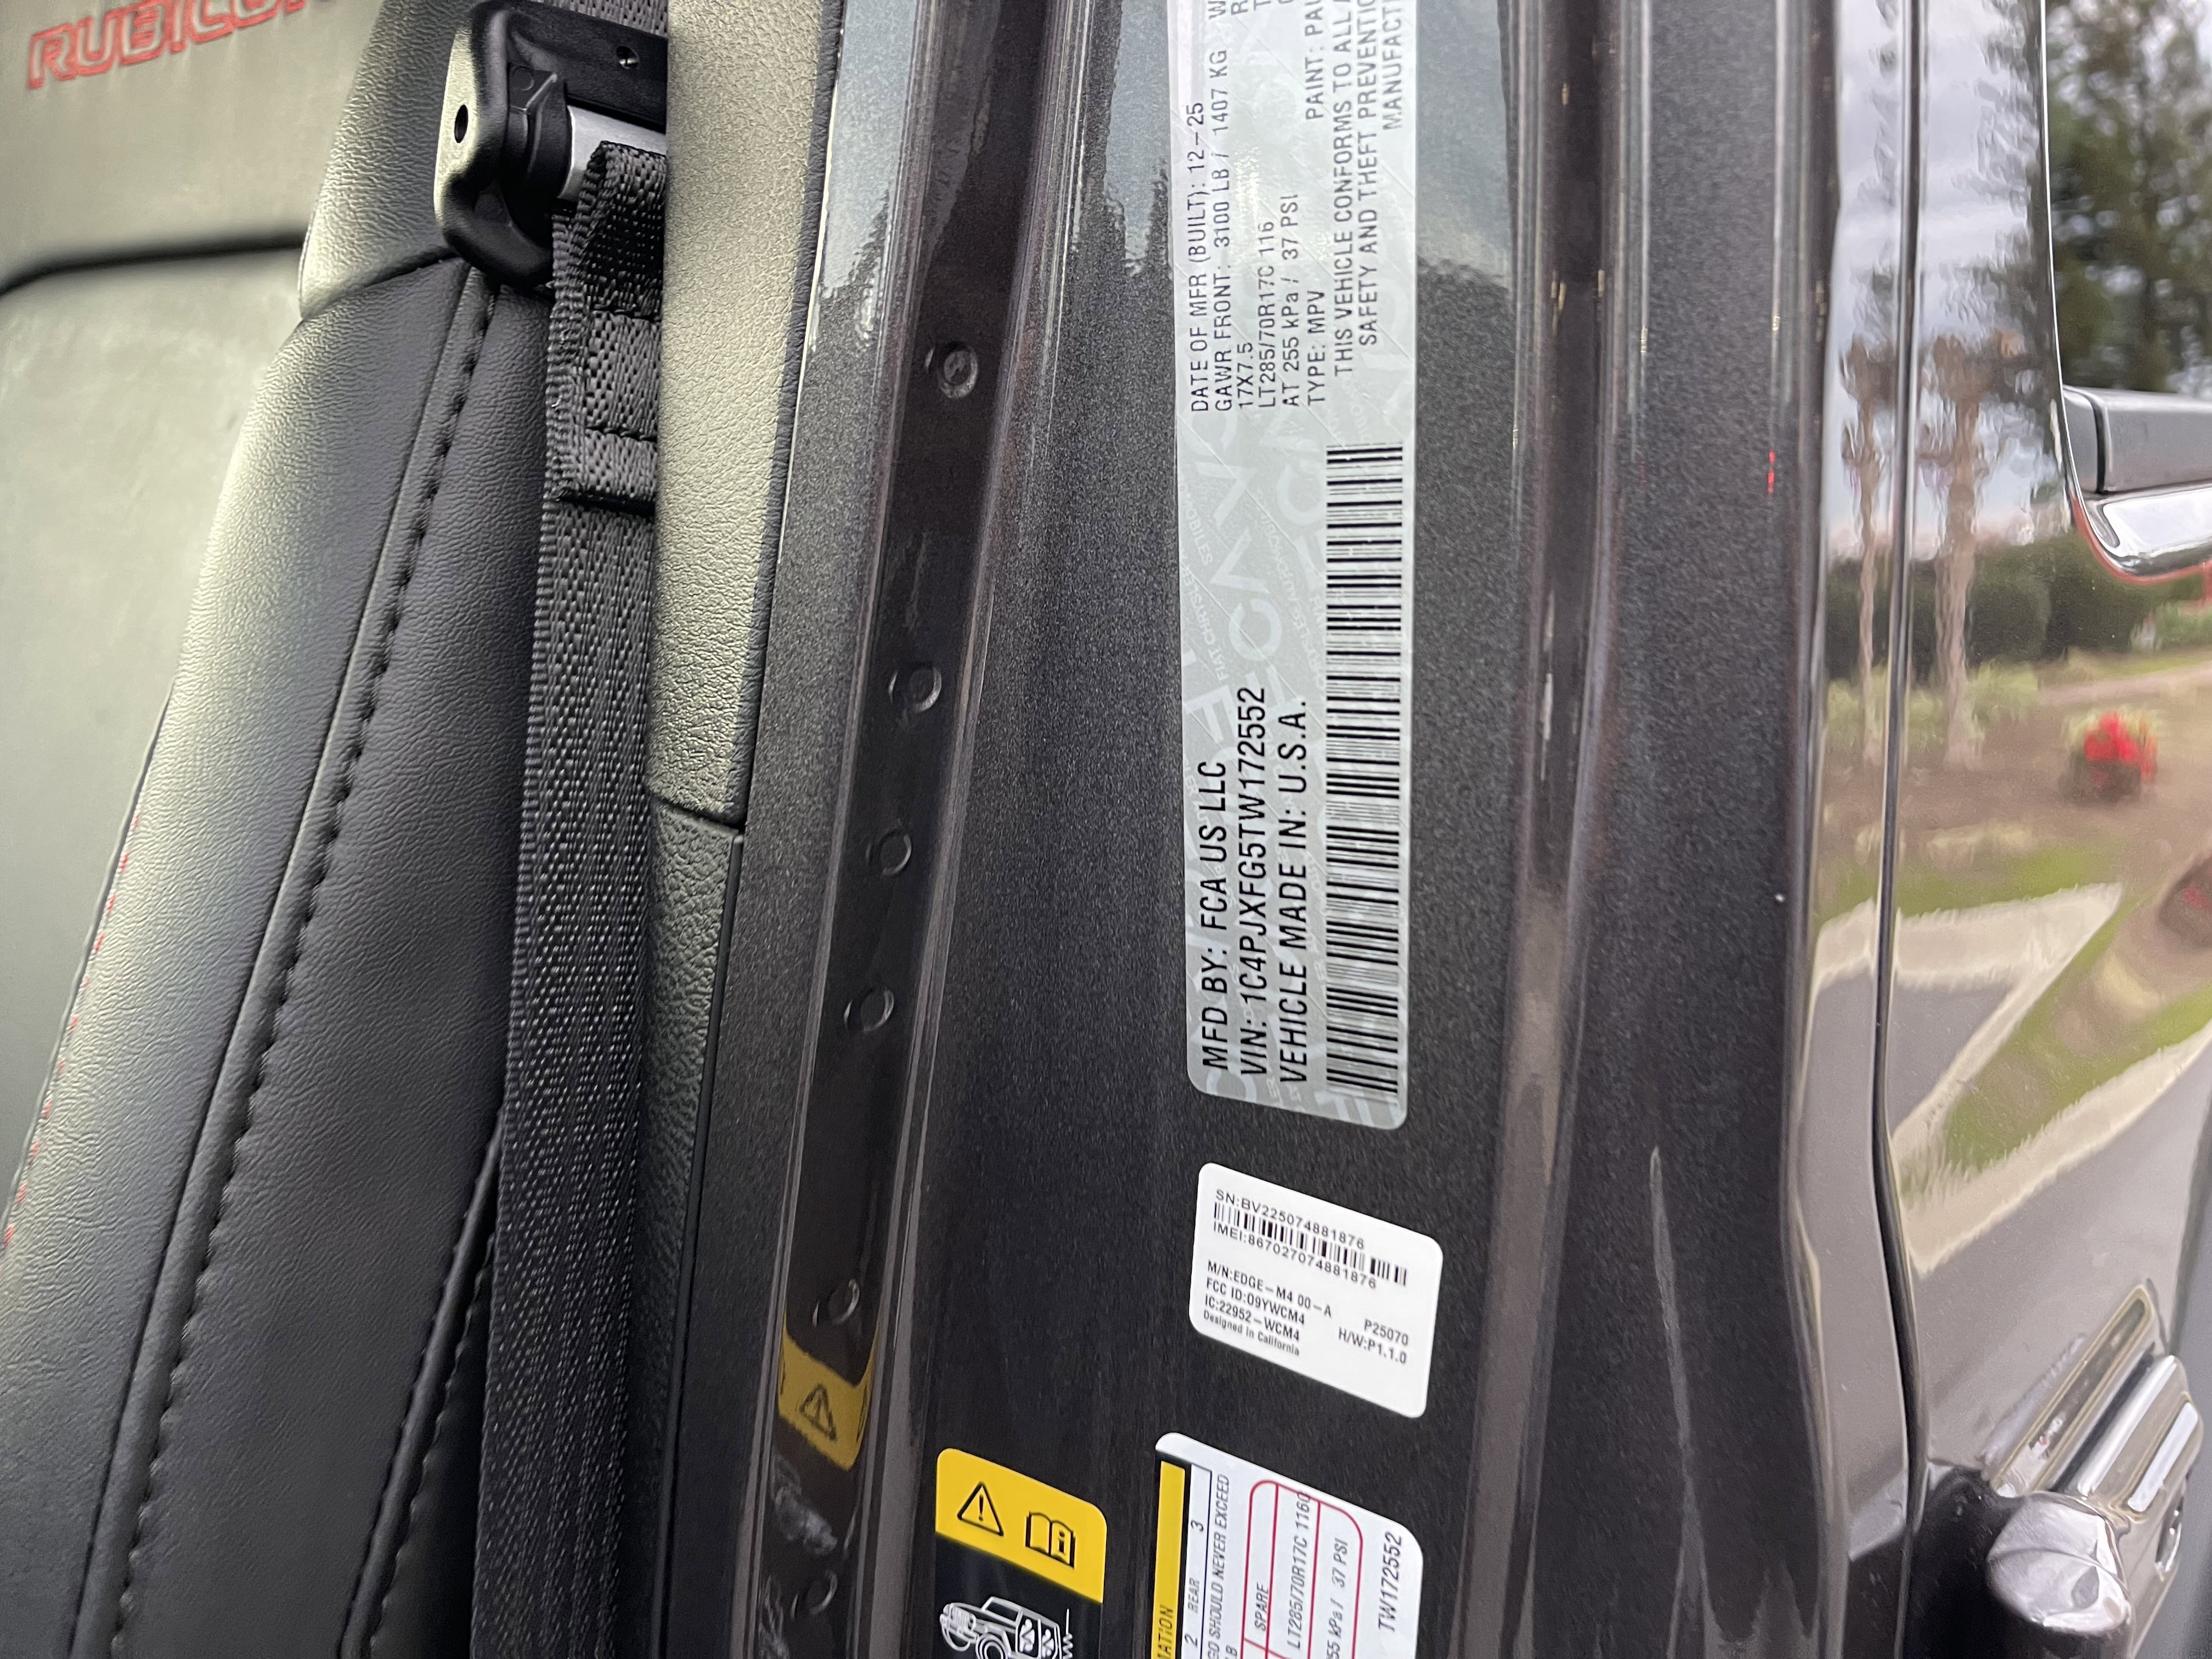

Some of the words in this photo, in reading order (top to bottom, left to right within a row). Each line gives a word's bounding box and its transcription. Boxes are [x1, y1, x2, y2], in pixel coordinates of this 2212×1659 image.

[1333, 12, 1351, 53] ALL
[1209, 50, 1228, 78] KG
[1305, 46, 1324, 120] PAINT:
[1333, 63, 1352, 93] TO
[1382, 0, 1402, 131] MANUFACT
[1211, 88, 1229, 136] 1407
[1211, 168, 1229, 192] LB
[1333, 99, 1353, 222] CONFORMS
[1357, 131, 1377, 201] THEFT
[1188, 183, 1211, 263] (BUILT):
[1213, 201, 1231, 247] 3100
[1280, 194, 1299, 228] PSI
[1358, 209, 1378, 255] AND
[1257, 221, 1276, 257] 116
[1281, 238, 1299, 261] 37
[1189, 274, 1207, 317] MFR
[1334, 231, 1353, 320] VEHICLE
[1213, 264, 1232, 340] FRONT:
[1282, 292, 1299, 329] kPa
[1307, 290, 1325, 334] MPV
[1358, 266, 1378, 346] SAFETY
[1189, 326, 1207, 352] OF
[1257, 266, 1276, 408] LT285/70R17C
[1282, 337, 1300, 373] 255
[1334, 328, 1353, 377] THIS
[1190, 360, 1209, 411] DATE
[1214, 349, 1232, 411] GAWR
[1236, 342, 1254, 410] 17X7.5
[1282, 382, 1300, 407] AT
[1307, 344, 1326, 406] TYPE:
[1278, 701, 1307, 793] U.S.A.
[1198, 761, 1227, 811] LLC
[1199, 825, 1228, 862] US
[1237, 687, 1267, 1003] 1C4PJXFG5TW172552
[1279, 809, 1307, 849] IN:
[1199, 878, 1228, 930] FCA
[1279, 863, 1307, 950] MADE
[1201, 947, 1228, 994] BY:
[1201, 1007, 1228, 1070] MFD
[1279, 962, 1307, 1082] VEHICLE
[1239, 1019, 1267, 1075] VIN:
[1216, 1189, 1364, 1250] SN:BV225074881876
[1214, 1221, 1378, 1289] IMEI:867027074881876
[1206, 1277, 1227, 1295] FCC
[1203, 1310, 1243, 1334] Designed
[1257, 1331, 1300, 1357] California
[1205, 1294, 1300, 1342] IC:22952-WCM4
[1364, 1318, 1409, 1346] P25070
[1338, 1326, 1407, 1365] H/W:P1.1.0
[1190, 1519, 1204, 1532] 3
[1215, 1474, 1230, 1530] EXCEED
[1211, 1532, 1227, 1581] NEVER
[1334, 1537, 1350, 1566] PSI
[1188, 1578, 1200, 1614] REAR
[1287, 1534, 1309, 1650] LT285/70R17C
[1331, 1567, 1346, 1589] 37
[1378, 1531, 1402, 1634] TW172552
[1209, 1582, 1224, 1639] SHOULD
[1254, 1582, 1270, 1632] SPARE
[1328, 1610, 1344, 1640] kPa
[1184, 1633, 1199, 1648] 2
